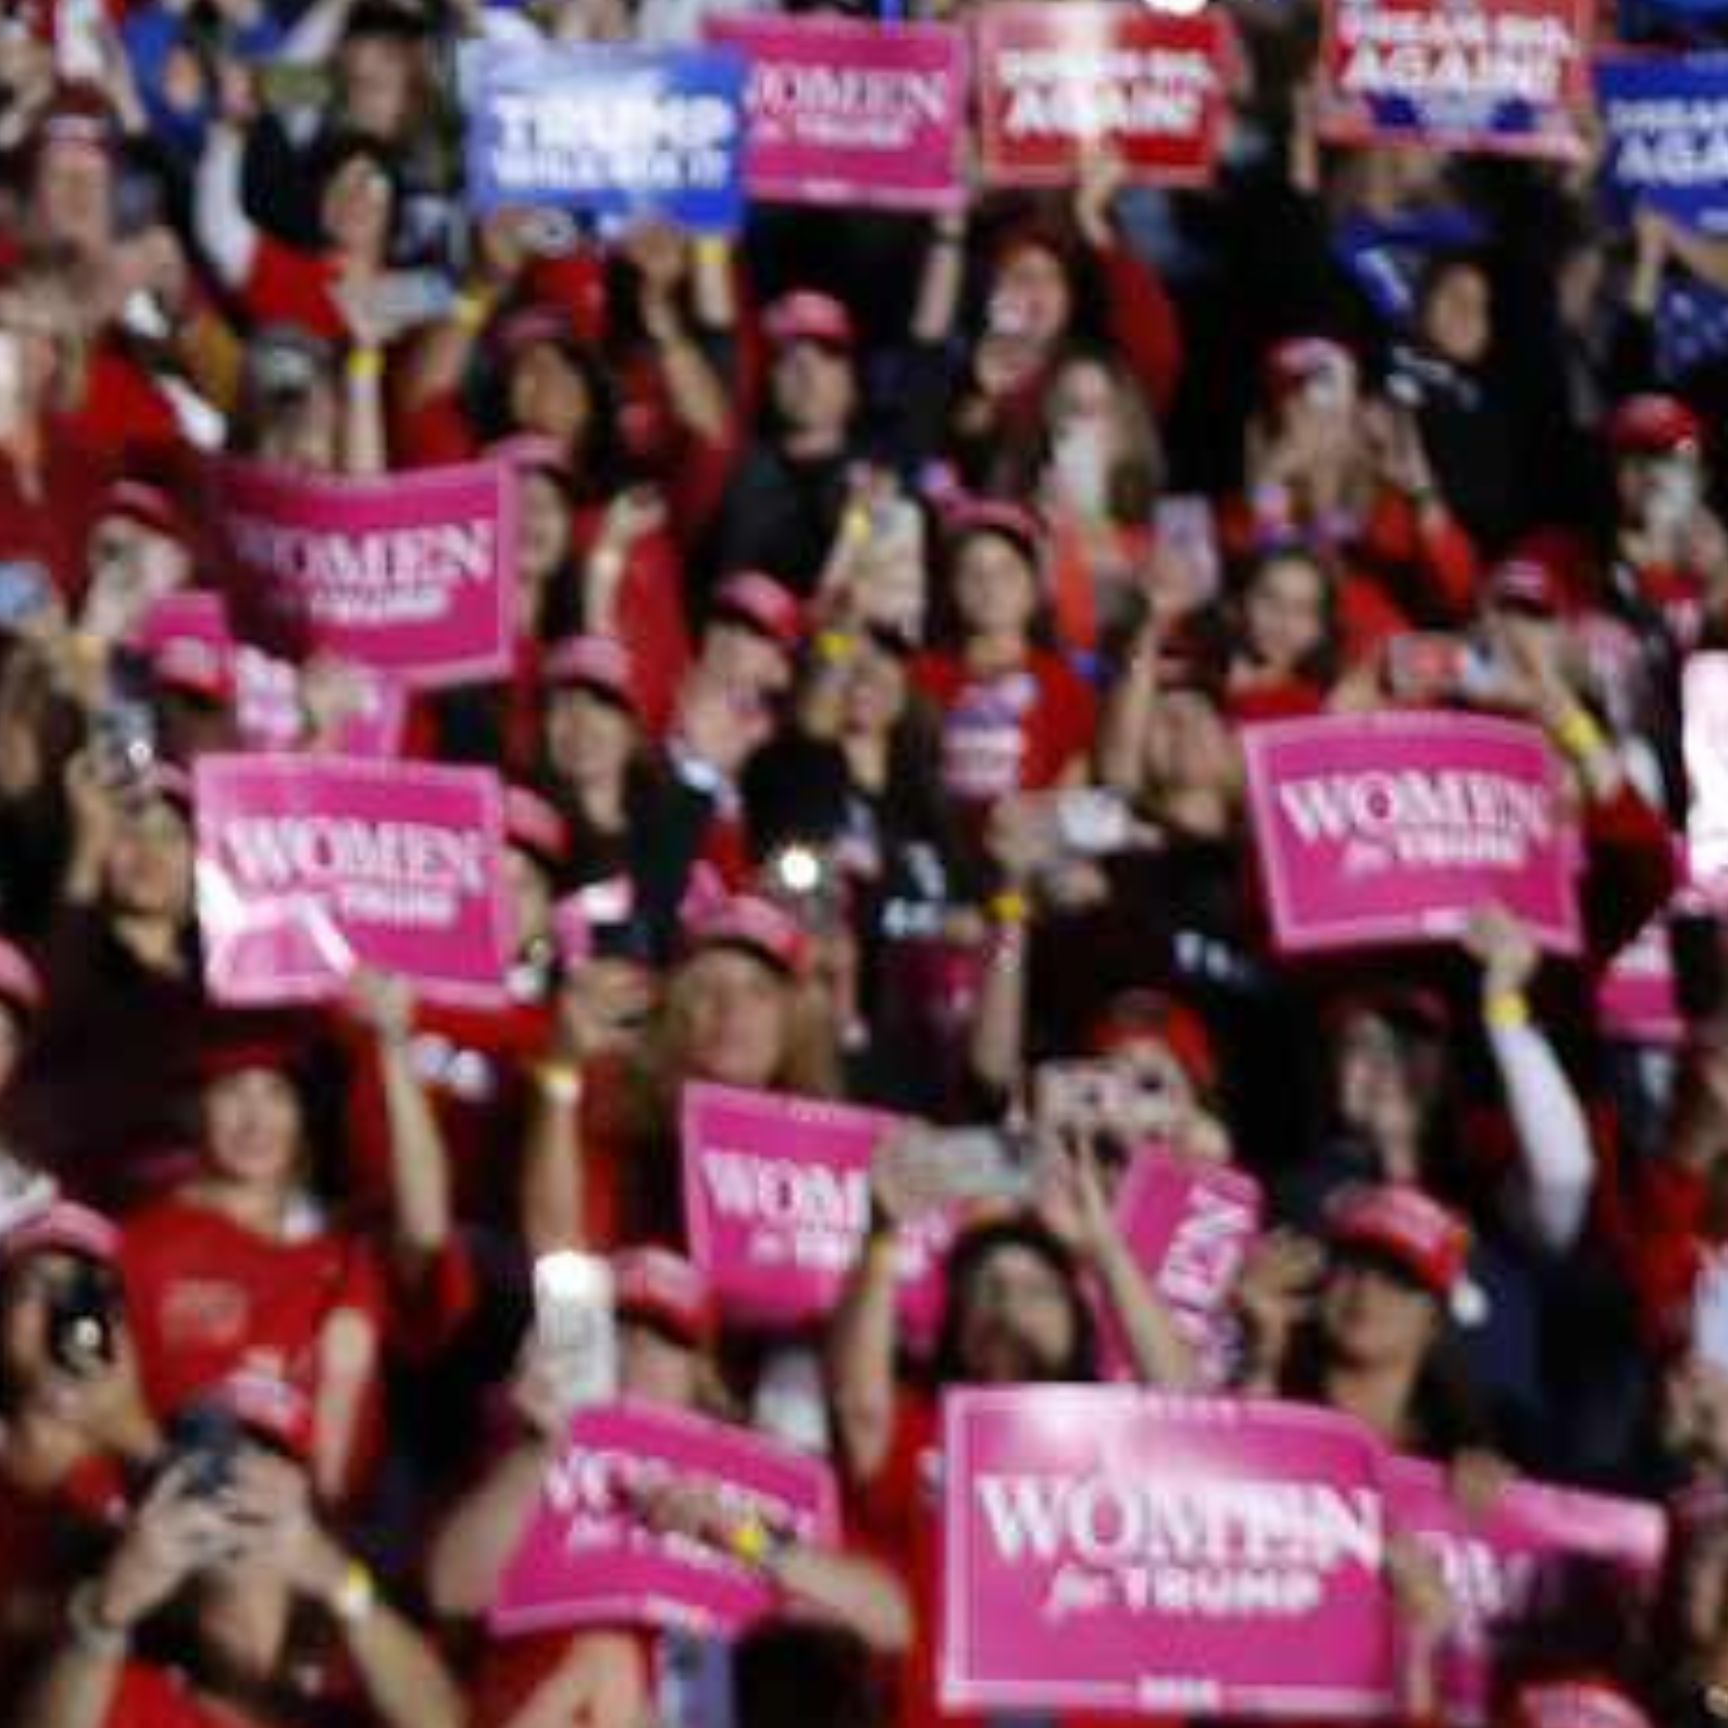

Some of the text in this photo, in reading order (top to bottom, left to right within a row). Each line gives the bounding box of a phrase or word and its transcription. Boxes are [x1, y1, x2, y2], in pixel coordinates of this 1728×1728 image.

[490, 92, 732, 152] TRUMP
[1277, 766, 1554, 844] WOMEN
[224, 815, 486, 892] WOMEN
[700, 1148, 872, 1234] WOM
[974, 1470, 1384, 1568] WOMEN
[1046, 1562, 1324, 1622] for TRUMP
